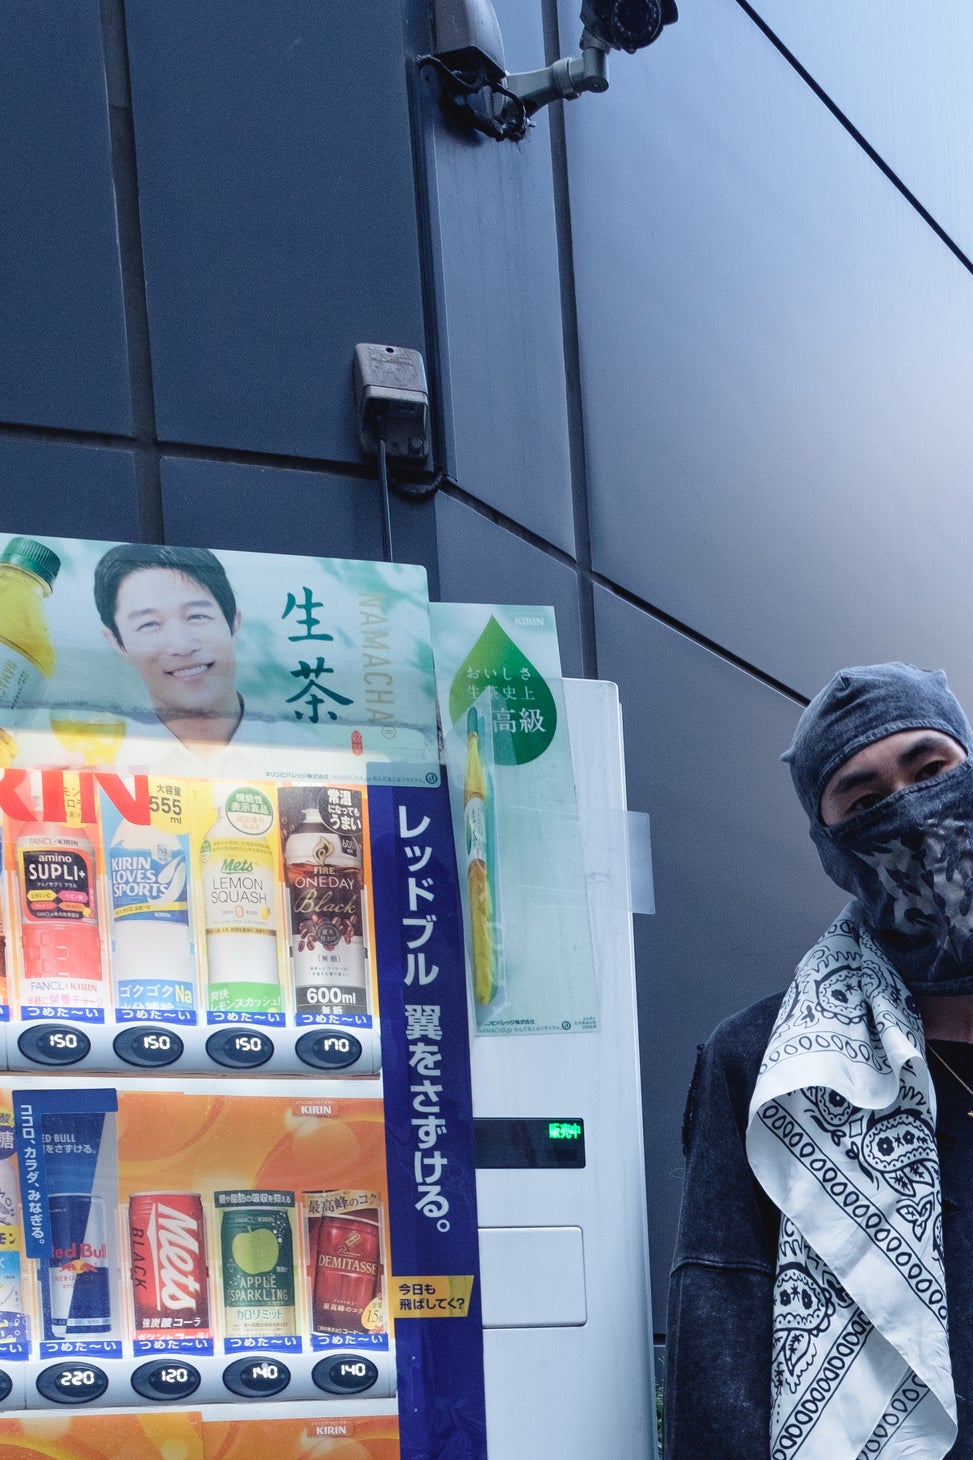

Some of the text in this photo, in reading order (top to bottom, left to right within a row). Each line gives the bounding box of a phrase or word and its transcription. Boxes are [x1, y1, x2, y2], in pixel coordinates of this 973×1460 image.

[514, 617, 544, 627] KIRIN
[281, 586, 354, 723] 生茶
[358, 592, 395, 724] NAMACHA
[467, 667, 531, 681] おいしさ
[157, 784, 182, 797] 大容量
[327, 788, 353, 806] 常温
[150, 796, 182, 816] 555
[328, 805, 360, 817] になっても
[330, 817, 362, 831] うまい
[38, 853, 72, 863] amino
[112, 856, 150, 871] KIRIN
[29, 863, 87, 881] SUPLI+
[221, 858, 253, 875] Mets
[313, 867, 335, 875] FIRE
[113, 870, 156, 884] LOVES
[212, 876, 264, 891] LEMON
[114, 883, 169, 898] SPORTS
[211, 890, 267, 905] SQUASH
[399, 805, 439, 986] レッドブル
[293, 887, 357, 914] Black
[31, 981, 98, 992] FANCL KIRIN
[306, 987, 356, 1005] 600ml
[50, 1034, 78, 1048] 150
[143, 1036, 170, 1049] 150
[235, 1037, 262, 1051] 150
[324, 1038, 350, 1052] 170
[300, 1105, 332, 1115] KIRIN
[405, 1004, 450, 1233] 翼をさずける。
[549, 1122, 581, 1139] 販売中
[54, 1134, 76, 1143] BULL
[43, 1145, 96, 1154] をさずける。
[20, 1104, 46, 1245] ココロ、カラダ、みなぎる。
[307, 1192, 378, 1214] 最高峰のコク
[79, 1243, 107, 1259] Bull
[157, 1202, 201, 1312] Mets
[131, 1227, 148, 1290] BLACK
[318, 1255, 378, 1275] DEMITASSE
[239, 1275, 277, 1288] APPLE
[229, 1289, 288, 1302] SPARKLING
[399, 1283, 436, 1296] 今日も
[399, 1298, 465, 1311] 飛ばしてく?
[236, 1309, 283, 1321] カロリミット
[142, 1317, 202, 1329] 強炭酸コーラ
[161, 1368, 188, 1383] 120
[252, 1365, 278, 1379] 140
[341, 1362, 366, 1377] 140
[61, 1371, 95, 1386] 220
[316, 1425, 347, 1436] KIRIN
